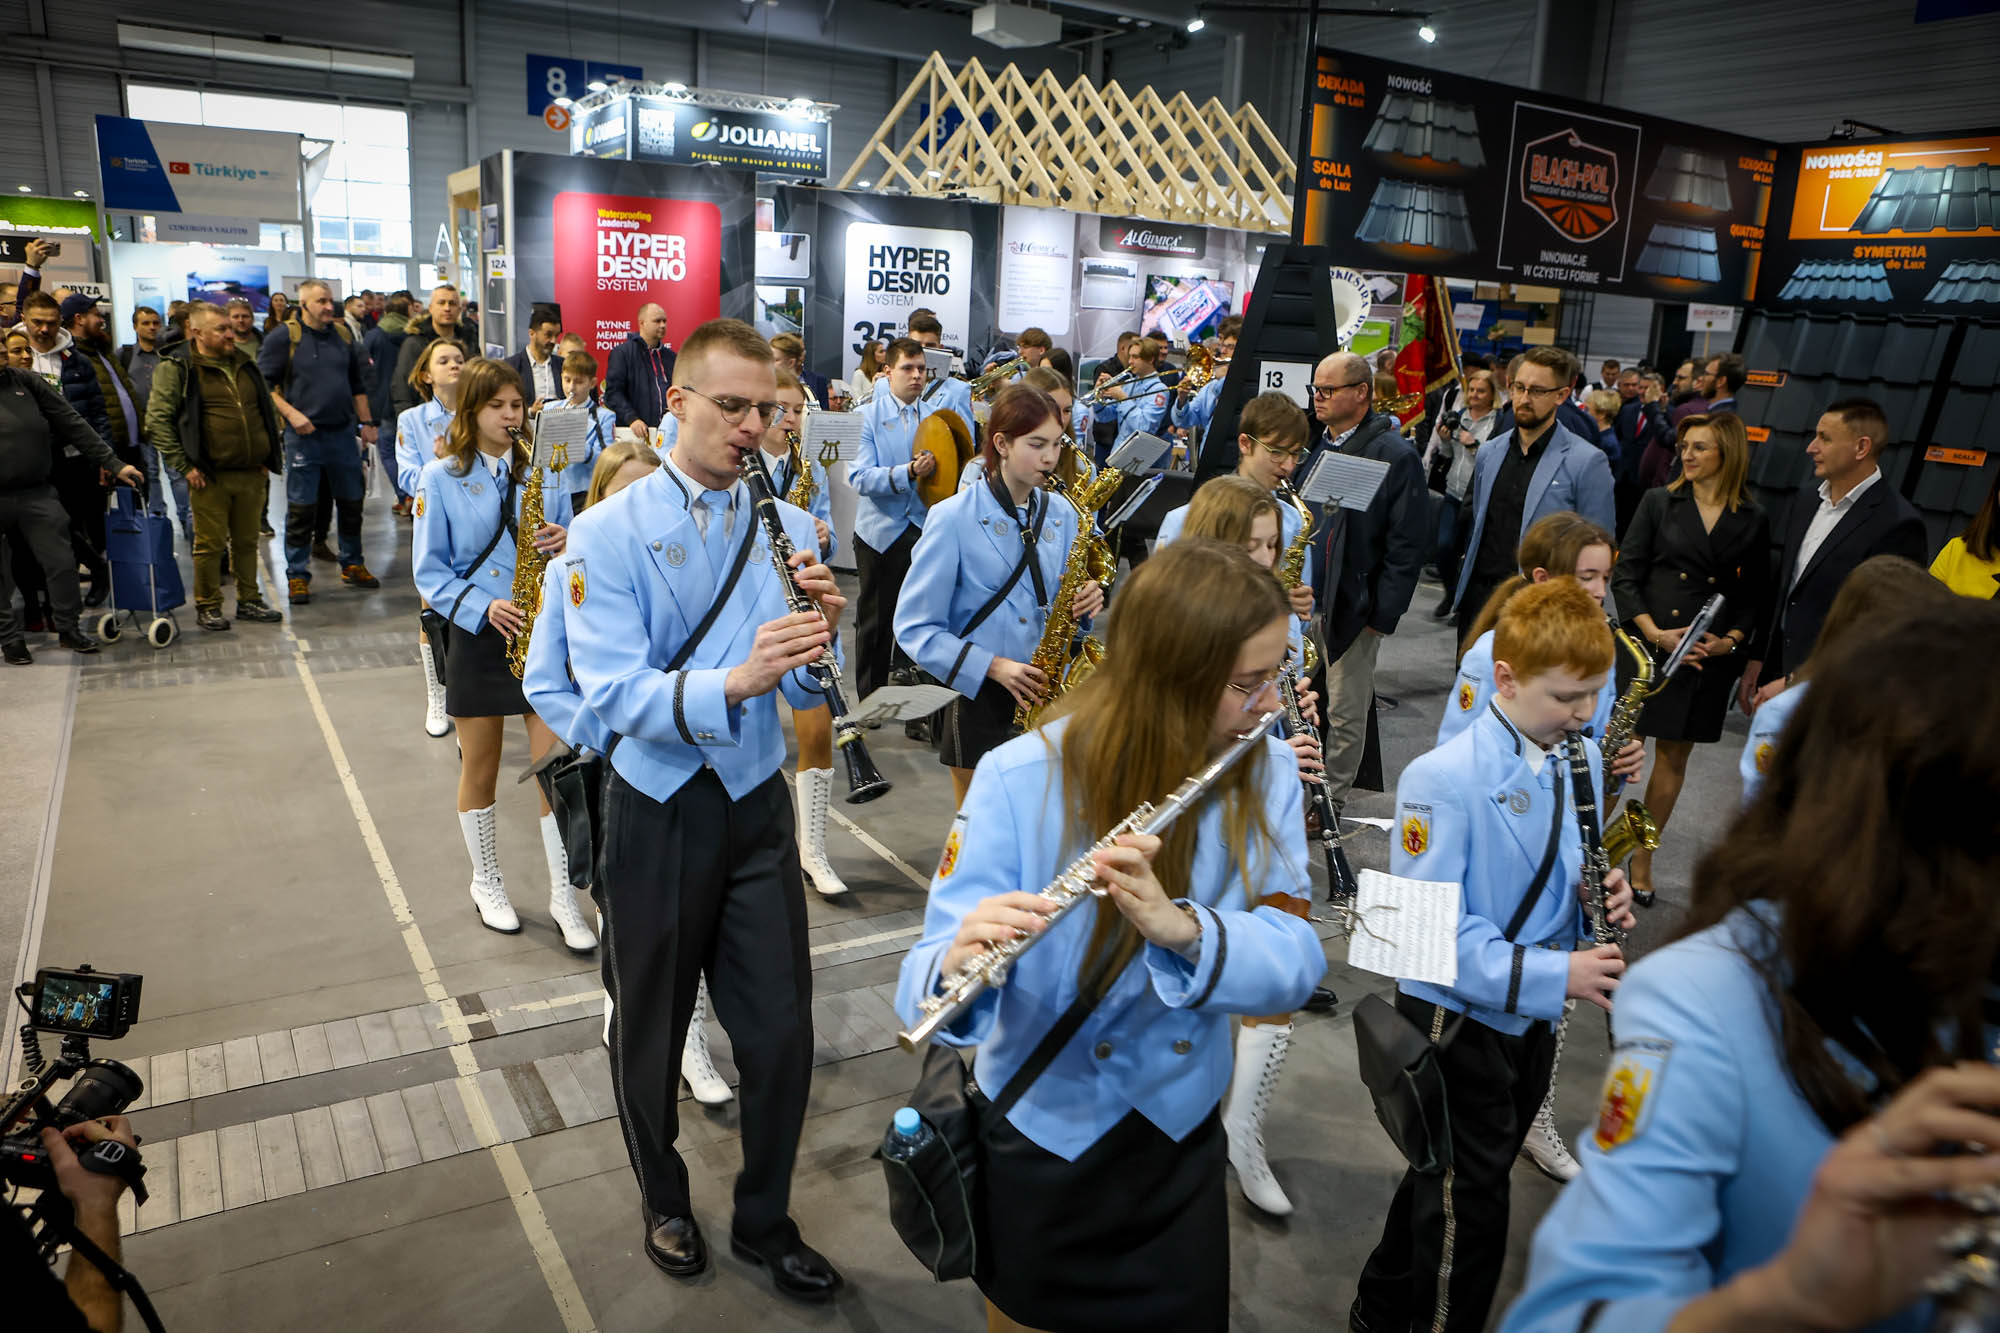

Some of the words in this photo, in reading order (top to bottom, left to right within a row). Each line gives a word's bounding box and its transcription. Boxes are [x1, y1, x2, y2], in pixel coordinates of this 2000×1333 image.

[546, 66, 567, 97] 8
[1317, 73, 1365, 96] DEKADA
[1387, 74, 1432, 94] NOWOŚĆ
[1333, 93, 1346, 104] de
[1348, 95, 1365, 108] Lux
[718, 124, 822, 153] JOUANEL
[691, 151, 738, 163] Producent
[741, 157, 774, 167] maszyn
[776, 160, 788, 168] od
[1312, 159, 1352, 178] SCALA
[1805, 149, 1883, 170] NOWOŚCI
[193, 162, 257, 182] Türkiye
[1530, 153, 1609, 193] BLACH-POL
[1319, 177, 1333, 189] de
[1334, 178, 1351, 191] Lux
[597, 208, 652, 223] Waterproofing
[597, 217, 640, 230] Leadership
[597, 230, 686, 260] HYPER
[1853, 244, 1927, 258] SYMETRIA
[597, 254, 687, 281] DESMO
[869, 245, 950, 272] HYPER
[1540, 249, 1587, 267] INNOWACJE
[1885, 260, 1901, 270] de
[1903, 260, 1927, 270] Lux
[868, 269, 950, 295] DESMO
[1523, 264, 1531, 276] W
[1533, 266, 1568, 280] CZYSTEJ
[1570, 270, 1600, 284] FORMIE
[597, 278, 648, 292] SYSTEM
[867, 293, 914, 306] SYSTEM
[1265, 370, 1283, 388] 13
